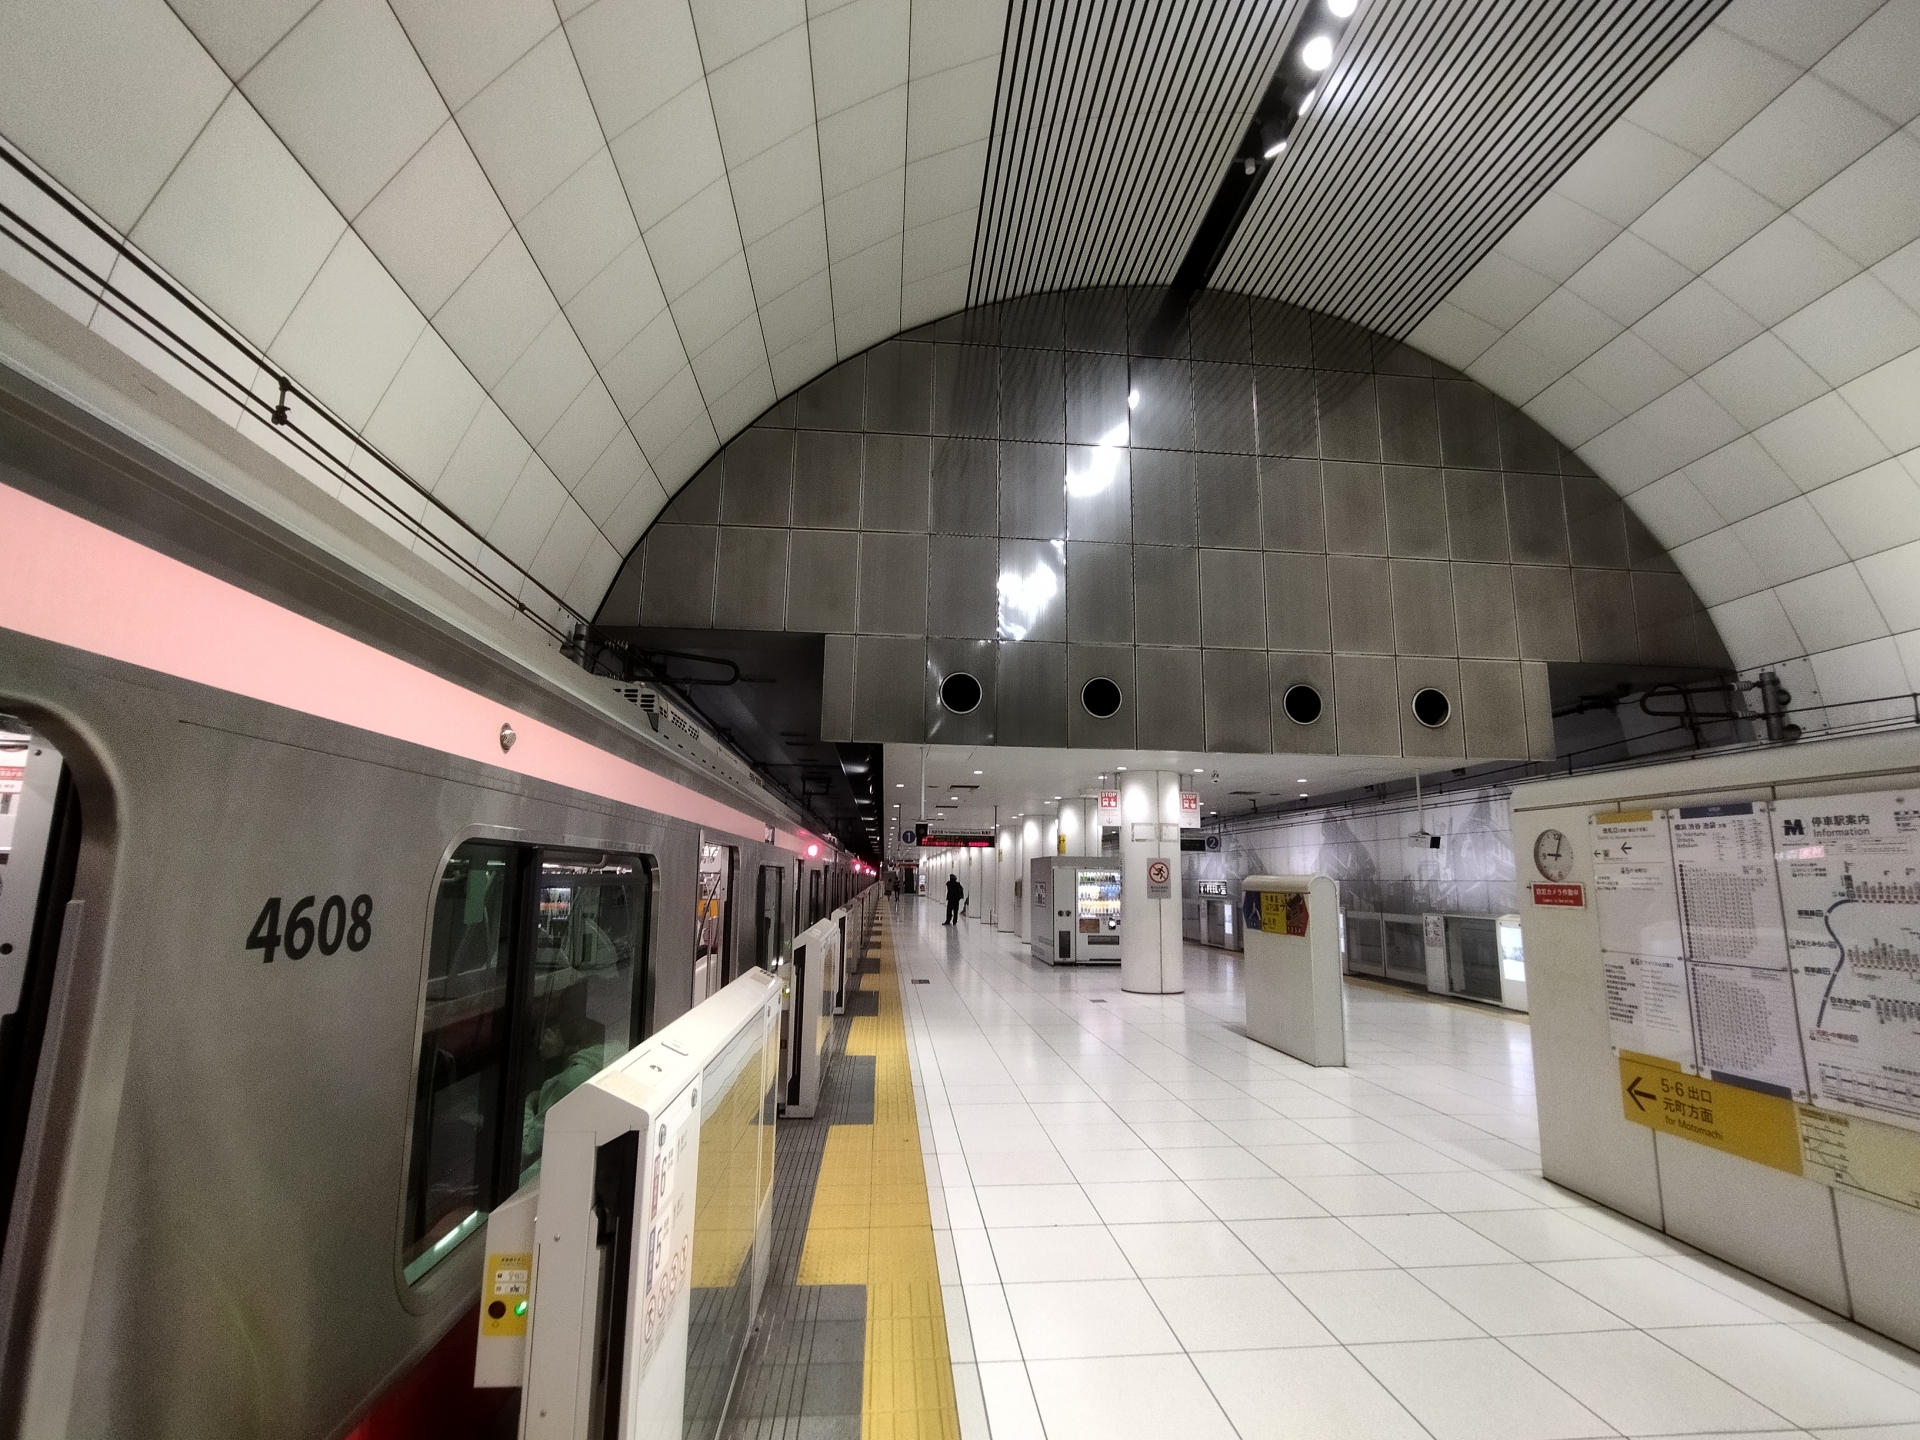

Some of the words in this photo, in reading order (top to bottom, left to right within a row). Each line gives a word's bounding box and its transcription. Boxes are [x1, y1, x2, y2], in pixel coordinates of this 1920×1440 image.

[1812, 814, 1870, 827] 停車駅案内
[1813, 828, 1870, 837] Information
[1209, 837, 1216, 848] 2
[1541, 852, 1547, 860] 9
[1557, 871, 1563, 879] 6
[245, 893, 374, 964] 4608
[1795, 939, 1828, 948] みなとみらい
[1688, 1085, 1713, 1104] 出口
[1663, 1097, 1714, 1124] 元町方面
[1665, 1115, 1676, 1125] for
[1678, 1118, 1724, 1141] Motomachi
[660, 1156, 667, 1198] 6
[655, 1227, 662, 1269] 5
